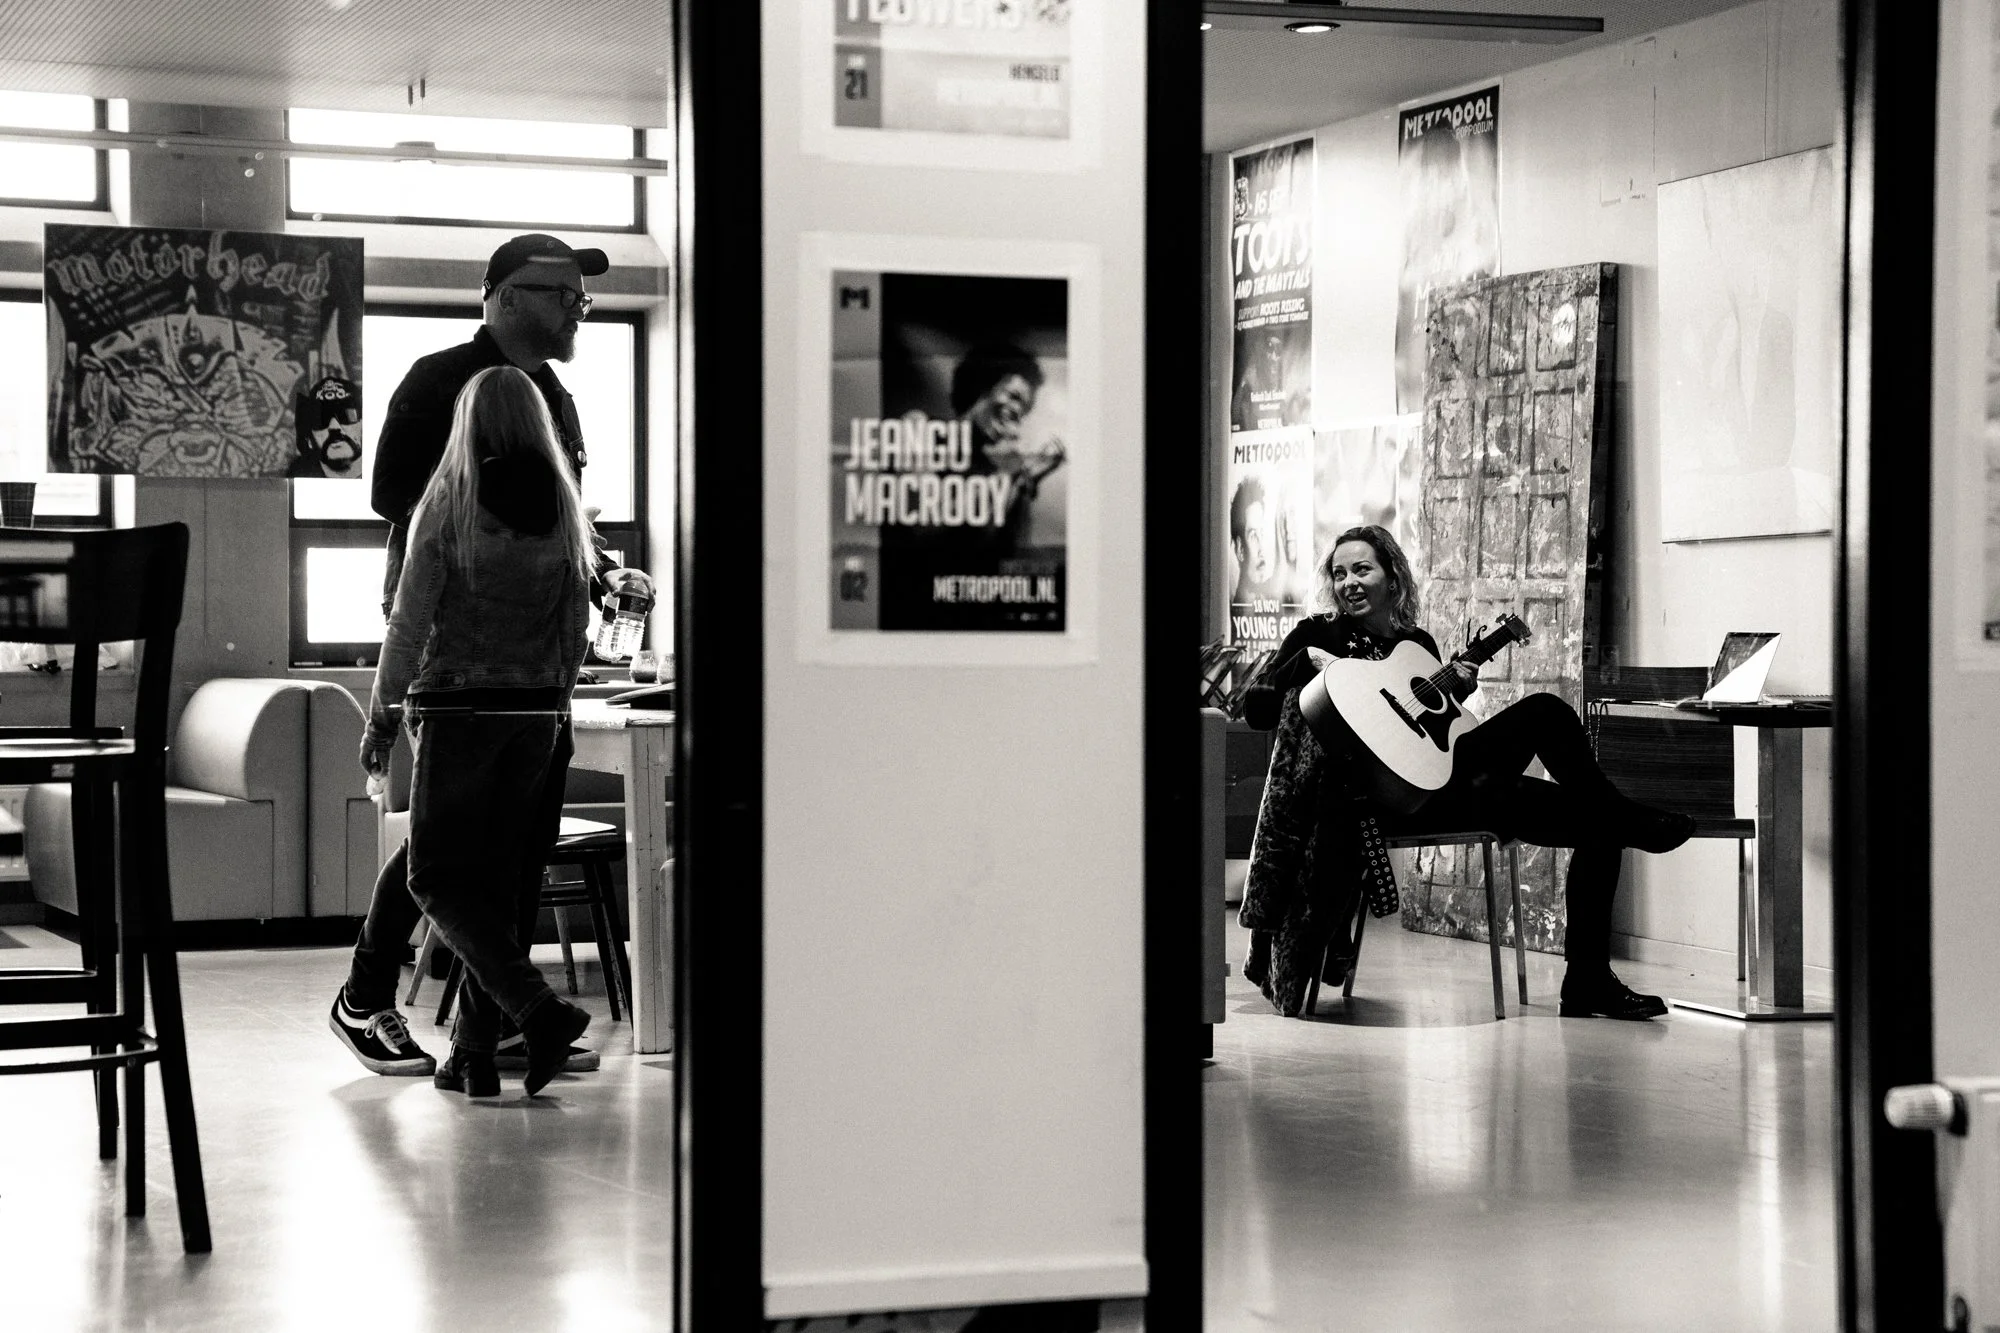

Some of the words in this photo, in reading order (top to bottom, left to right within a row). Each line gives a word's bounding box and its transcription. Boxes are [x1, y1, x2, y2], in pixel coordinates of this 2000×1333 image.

[844, 68, 869, 100] 21
[1253, 190, 1269, 216] 16
[1234, 216, 1309, 276] TOOTS
[1235, 279, 1253, 300] AND
[1266, 264, 1311, 294] MAYTALS
[1260, 301, 1281, 317] ROOTS
[1281, 297, 1305, 313] RISING
[843, 418, 972, 471] JEANGU
[845, 472, 1011, 527] MACROOY
[932, 574, 1058, 604] METROPOOL.NL
[1254, 599, 1264, 613] 18
[1264, 599, 1280, 613] NOV
[1233, 616, 1278, 639] YOUNG
